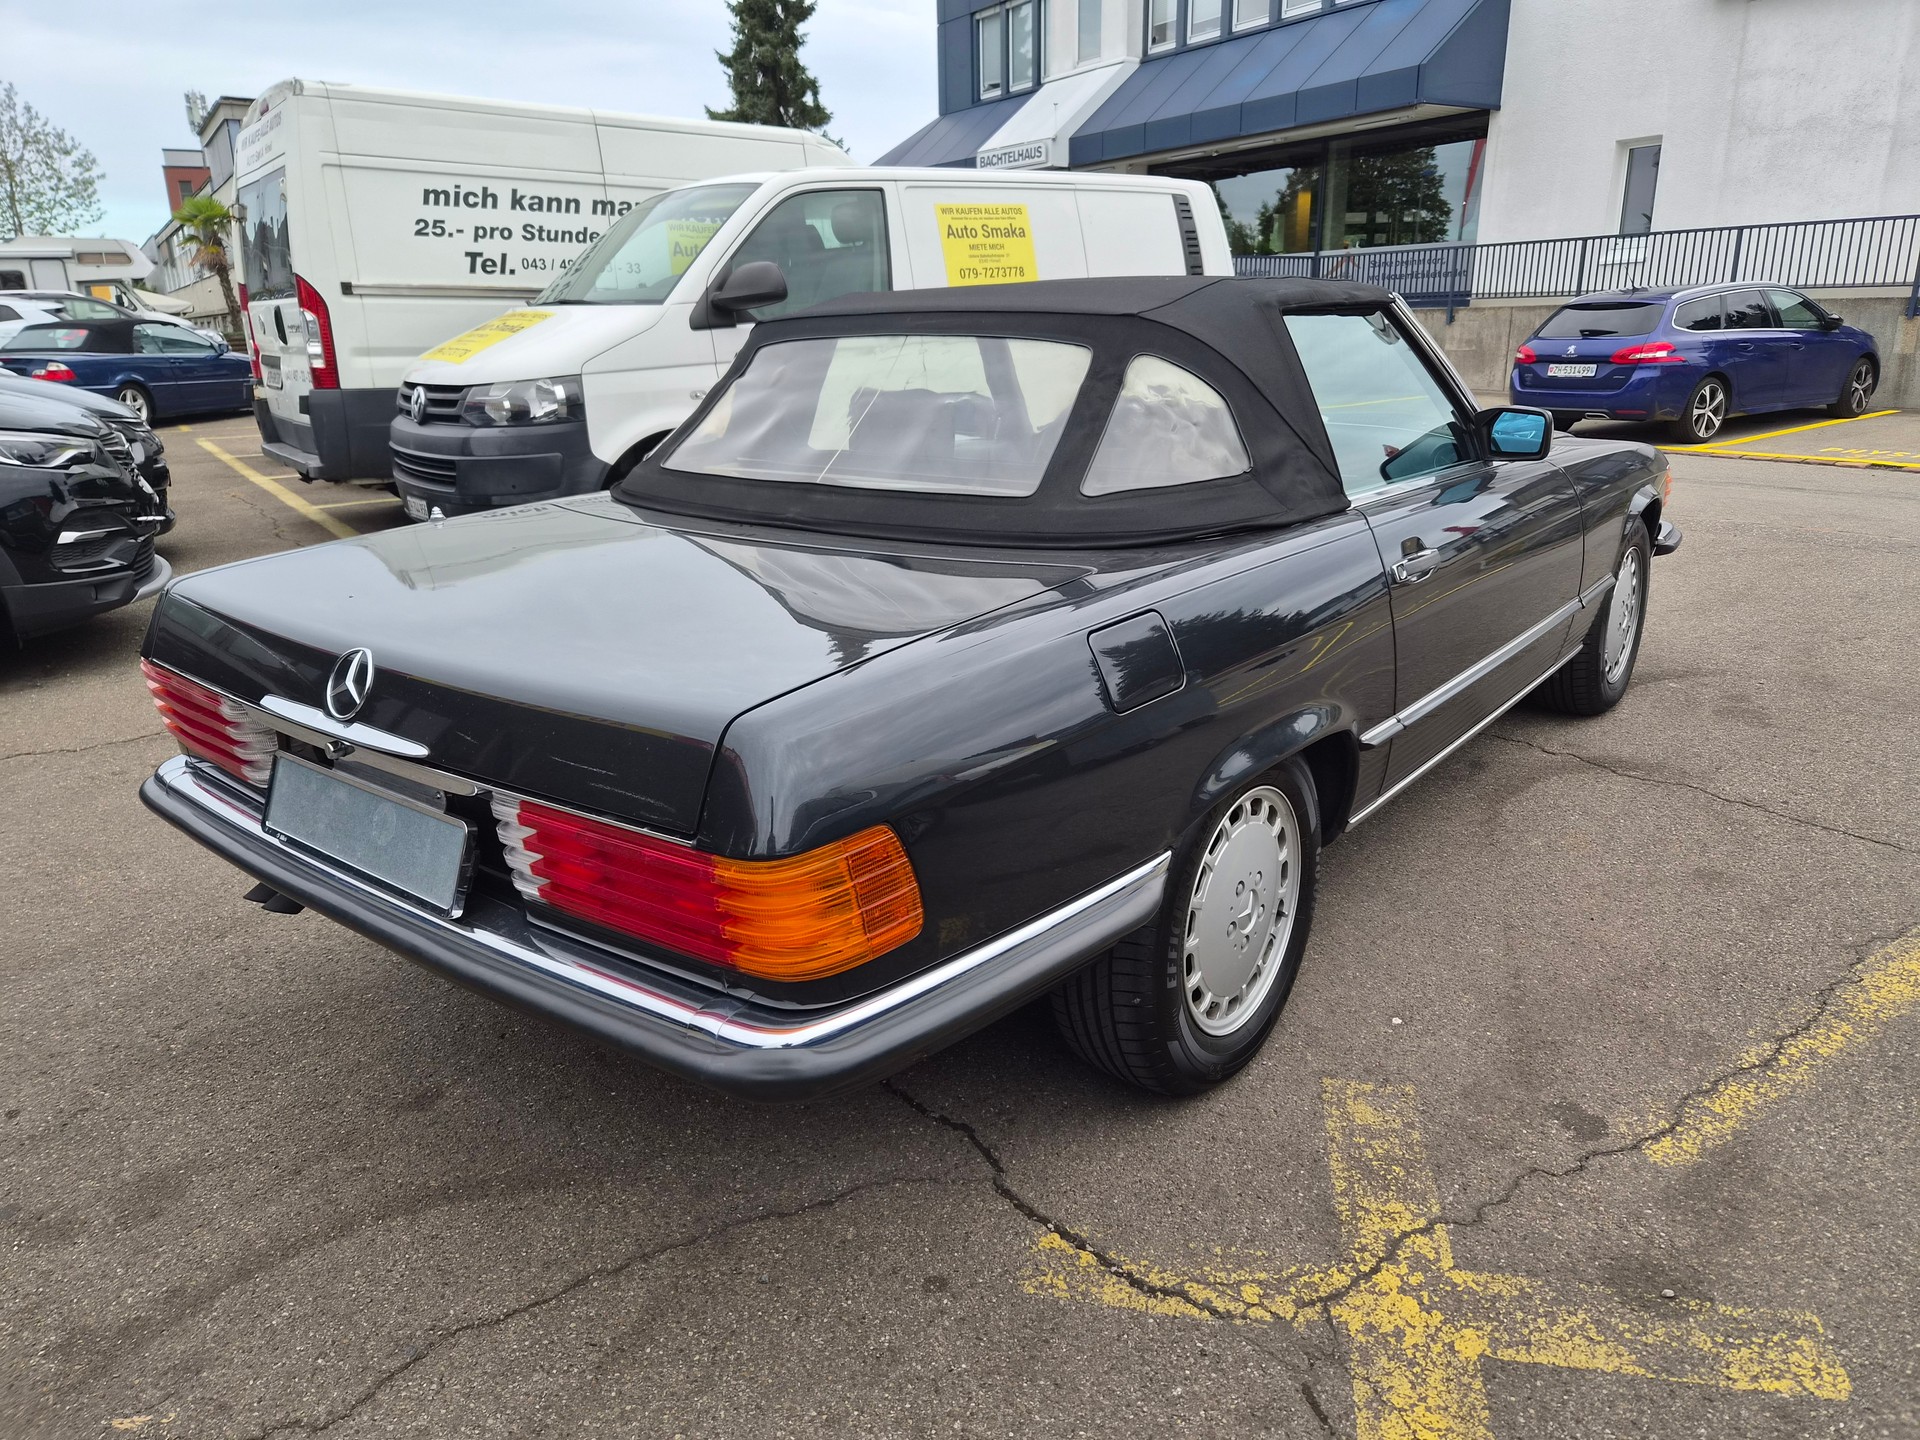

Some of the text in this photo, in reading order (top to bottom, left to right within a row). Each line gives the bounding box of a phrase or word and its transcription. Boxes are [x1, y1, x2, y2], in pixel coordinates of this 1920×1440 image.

[980, 146, 1042, 168] BACHTELHAUS
[423, 185, 641, 217] mich kann ma
[940, 207, 1022, 215] WIR KAUFEN ALLE AUTOS
[414, 218, 601, 244] 25.- pro Stunde
[947, 223, 1026, 239] Auto Smaka
[673, 241, 702, 257] Aut
[465, 251, 516, 275] Tel.
[521, 257, 546, 270] 043
[959, 266, 1025, 279] 079-7273778
